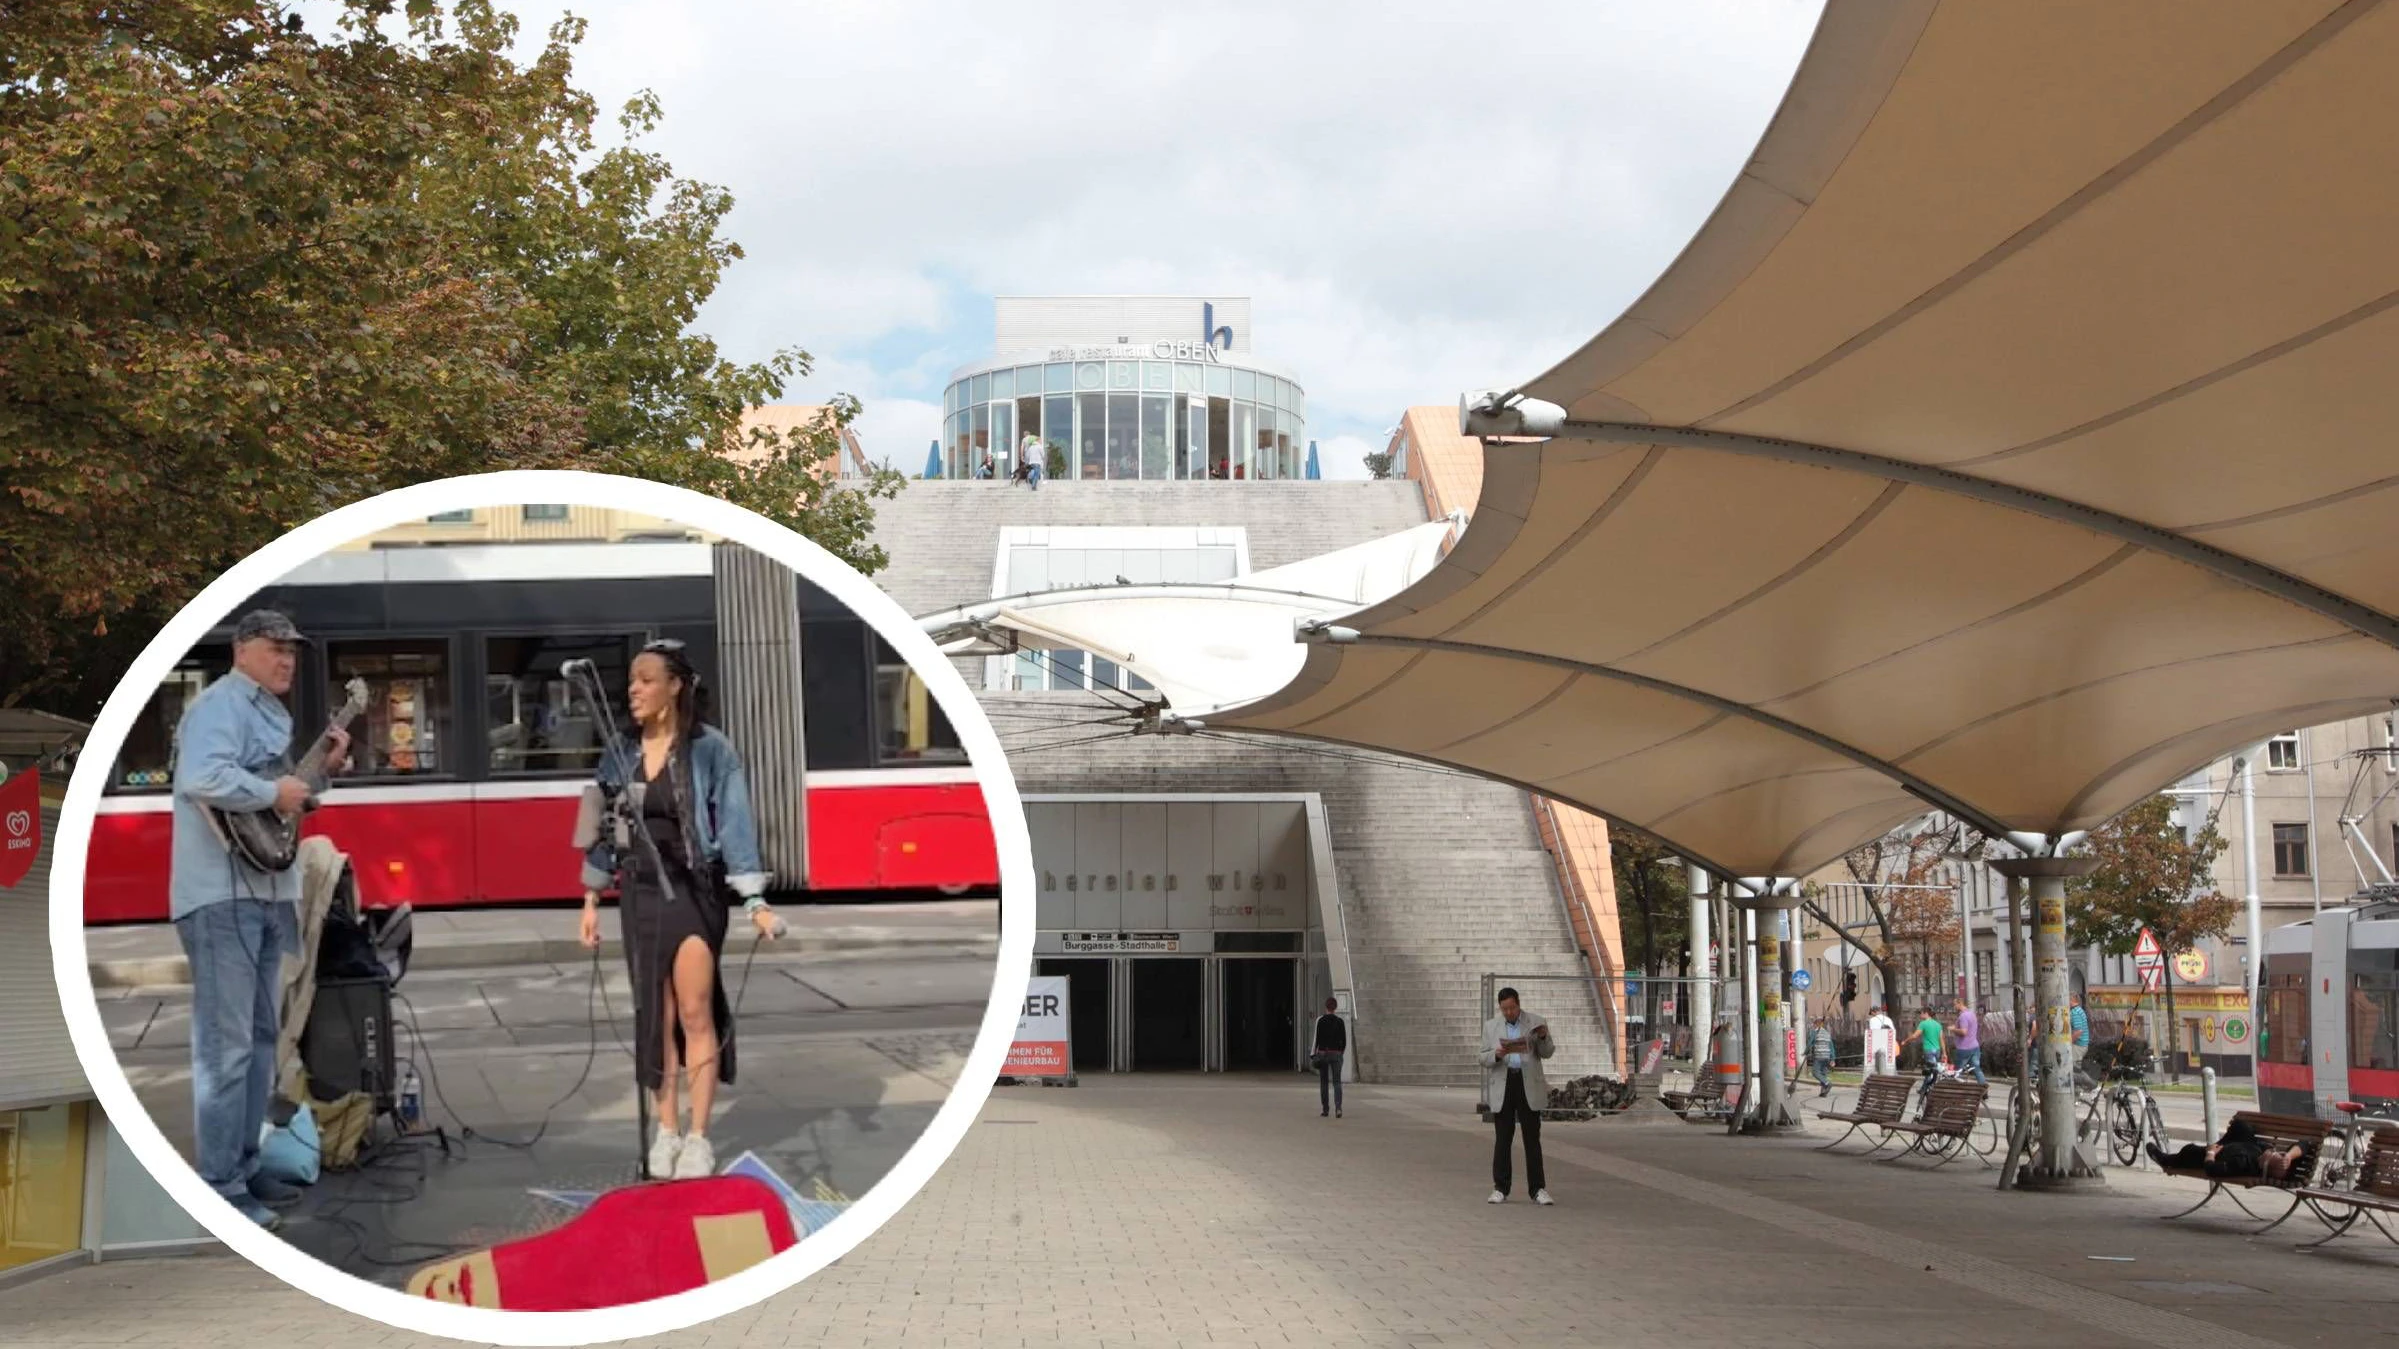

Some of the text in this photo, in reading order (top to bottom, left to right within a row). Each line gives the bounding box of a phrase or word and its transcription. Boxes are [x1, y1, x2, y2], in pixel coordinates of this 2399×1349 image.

[1154, 339, 1220, 362] OBEN
[1078, 362, 1202, 391] OBEN
[1207, 870, 1287, 892] wien
[1021, 994, 1059, 1017] ER
[1030, 1045, 1053, 1056] FÜR
